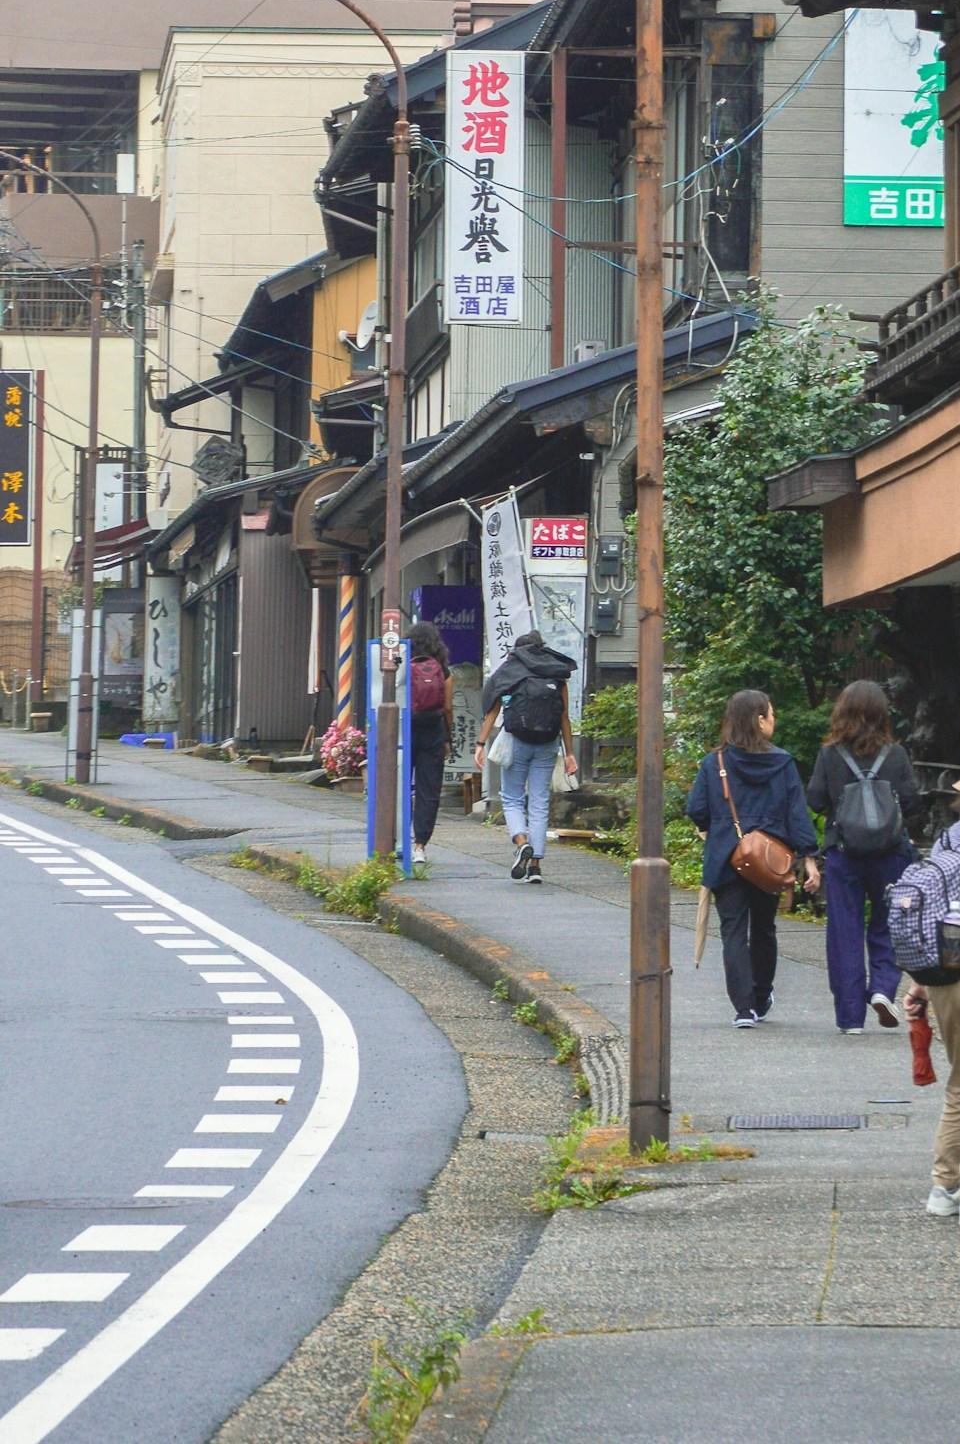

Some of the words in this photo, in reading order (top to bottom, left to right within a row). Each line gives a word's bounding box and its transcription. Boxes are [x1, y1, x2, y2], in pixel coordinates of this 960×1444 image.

[461, 59, 509, 155] 地酒
[868, 186, 945, 220] 吉田
[454, 274, 516, 295] 吉田屋
[459, 296, 508, 316] 酒店
[533, 523, 586, 541] たばこ
[433, 608, 476, 624] Asahi
[146, 598, 168, 706] ひしや
